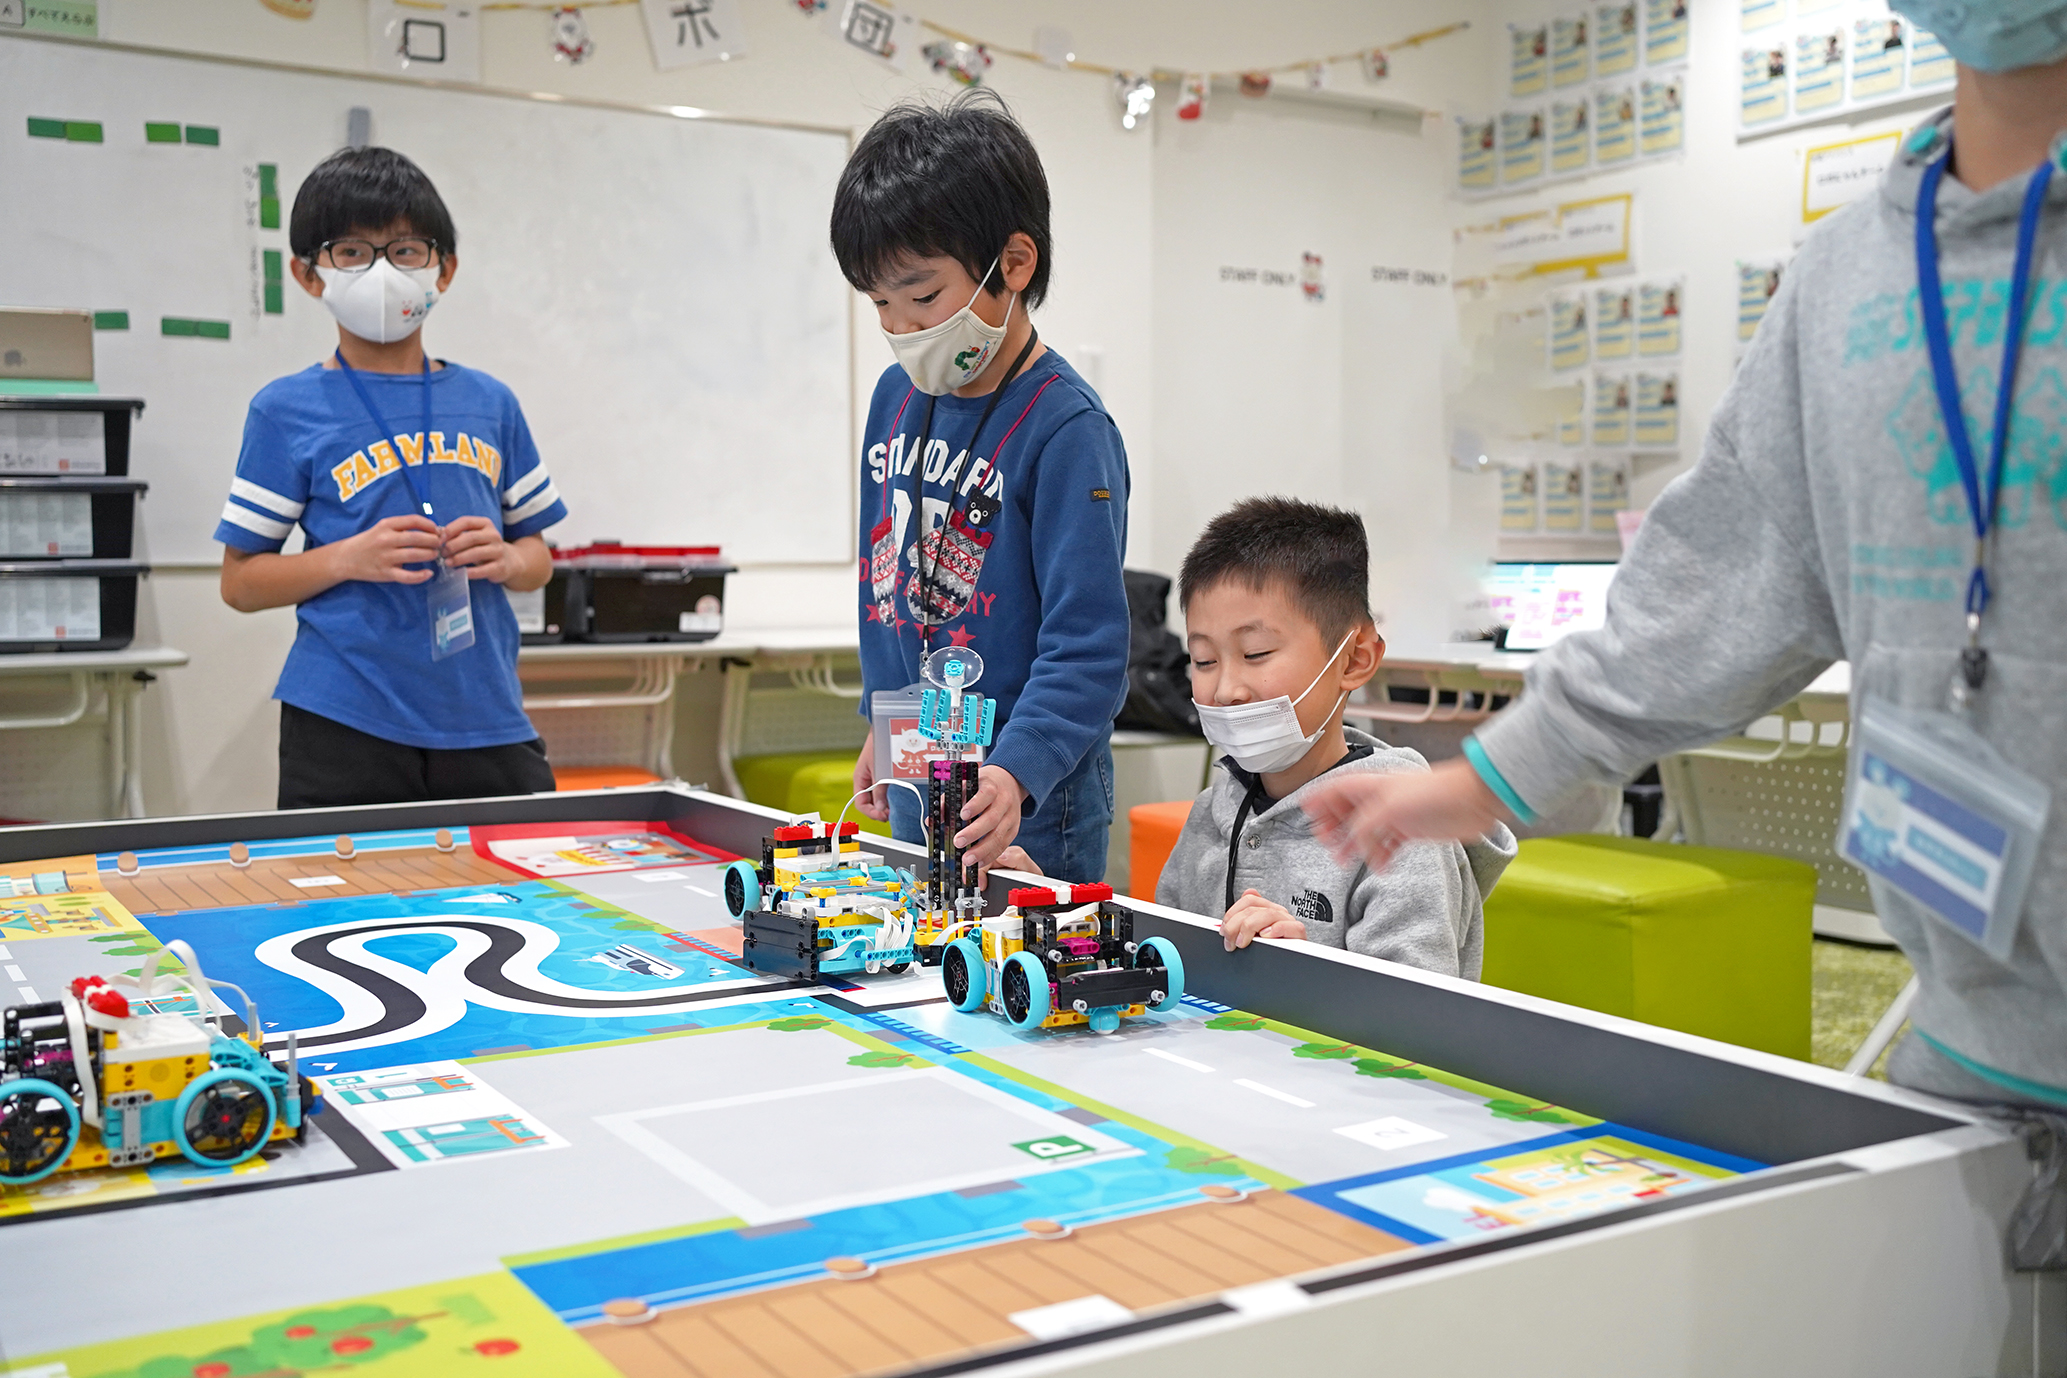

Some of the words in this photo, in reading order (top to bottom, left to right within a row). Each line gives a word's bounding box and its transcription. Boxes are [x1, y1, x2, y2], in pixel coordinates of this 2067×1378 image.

[1219, 266, 1259, 282] STAFF
[1260, 269, 1296, 286] ONLY
[1371, 266, 1410, 282] STAFF
[1411, 269, 1448, 286] ONLY
[331, 431, 502, 503] FARMLAND
[1304, 889, 1317, 900] THE
[1291, 895, 1317, 910] NORTH
[1295, 907, 1315, 920] FACE
[1028, 1142, 1083, 1157] P
